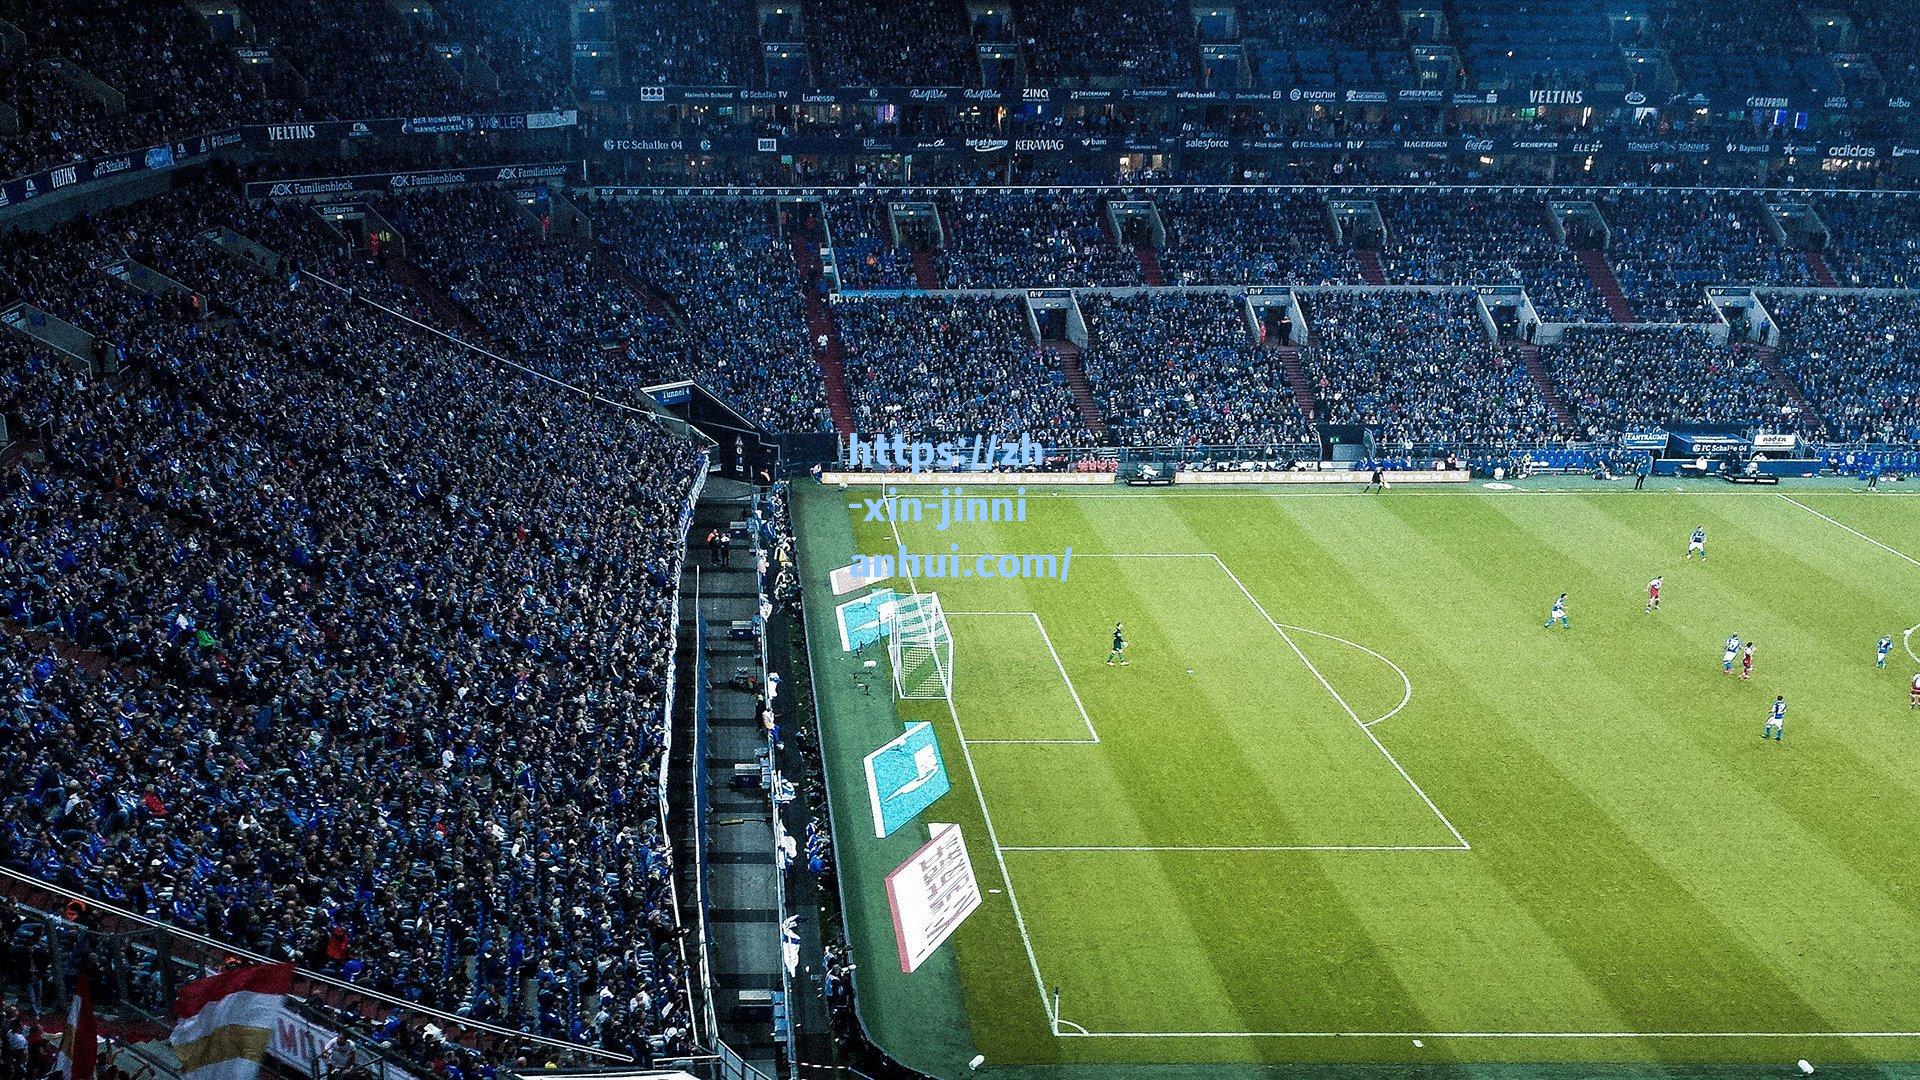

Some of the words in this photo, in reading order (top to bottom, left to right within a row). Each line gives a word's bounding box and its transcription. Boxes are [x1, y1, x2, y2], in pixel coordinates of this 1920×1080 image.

[749, 90, 777, 99] Schalke
[1022, 88, 1049, 98] ZINQ
[1529, 90, 1583, 104] VELTINS
[268, 125, 315, 140] VELTINS
[617, 140, 630, 149] FC
[632, 140, 669, 149] Schalke
[671, 140, 683, 149] 04
[1015, 139, 1064, 150] KERAMAG
[1185, 138, 1229, 149] salesforce
[1829, 144, 1876, 157] adidas
[51, 166, 77, 189] VELTINS
[497, 168, 517, 180] AOK
[518, 165, 568, 179] Familienblock
[391, 175, 410, 187] AOK
[411, 172, 465, 187] Familienblock
[269, 183, 293, 196] AOK
[294, 180, 354, 195] Familienblock
[662, 388, 685, 399] Tunnel
[685, 387, 690, 395] 4
[1701, 444, 1711, 452] FC
[1738, 444, 1748, 452] 04
